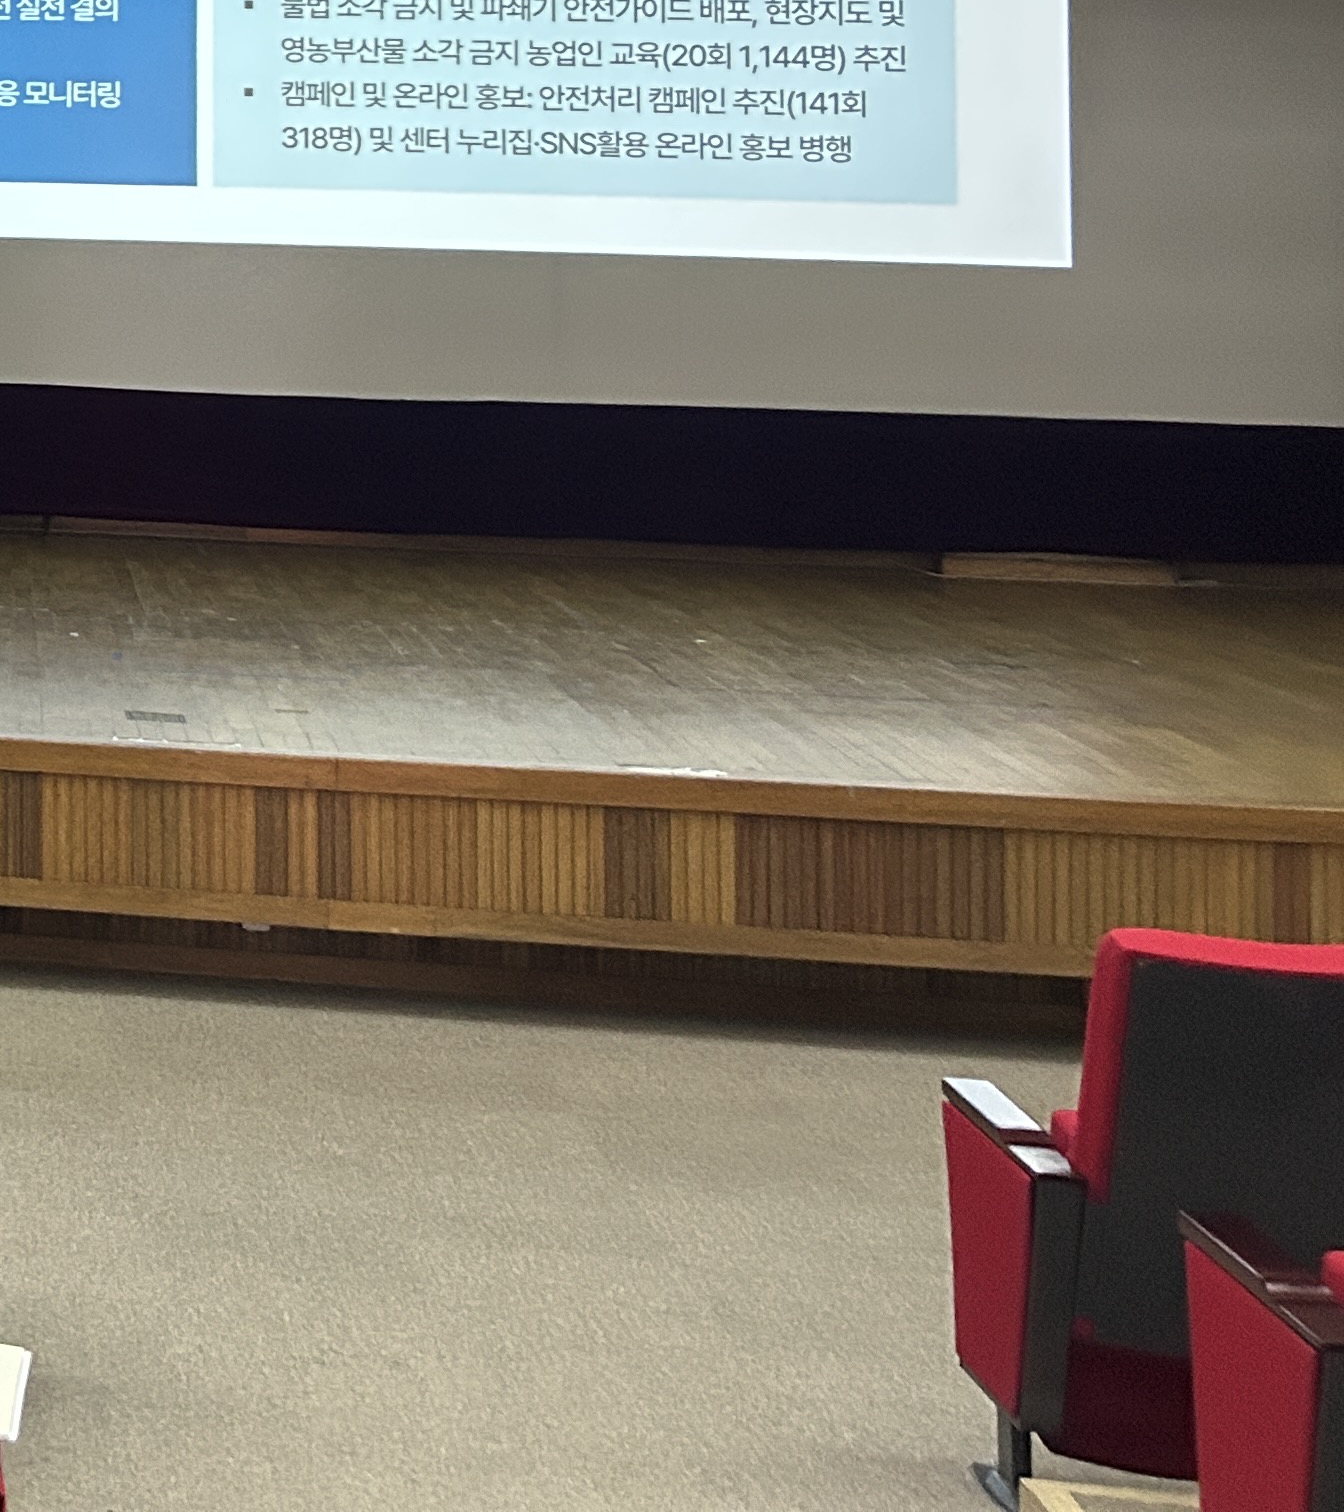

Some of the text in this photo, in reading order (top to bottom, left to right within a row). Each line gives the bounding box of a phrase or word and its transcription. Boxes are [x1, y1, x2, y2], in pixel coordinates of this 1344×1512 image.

[879, 0, 904, 27] 및
[282, 37, 407, 64] 영농부산물
[413, 39, 463, 65] 소각
[469, 40, 518, 66] 금지
[526, 40, 602, 67] 농업인
[739, 44, 845, 75] 1,144명)
[853, 45, 906, 72] 추진
[23, 81, 120, 108] 모니터링
[282, 81, 866, 120] 캠페인 및 온라인 홍보: 안전처리 캠페인 추진(141회
[282, 126, 361, 155] 318명)
[370, 126, 393, 152] 및
[401, 127, 449, 154] 센터
[655, 133, 732, 160] 온라인
[740, 134, 793, 161] 홍보
[800, 135, 851, 163] 병행
